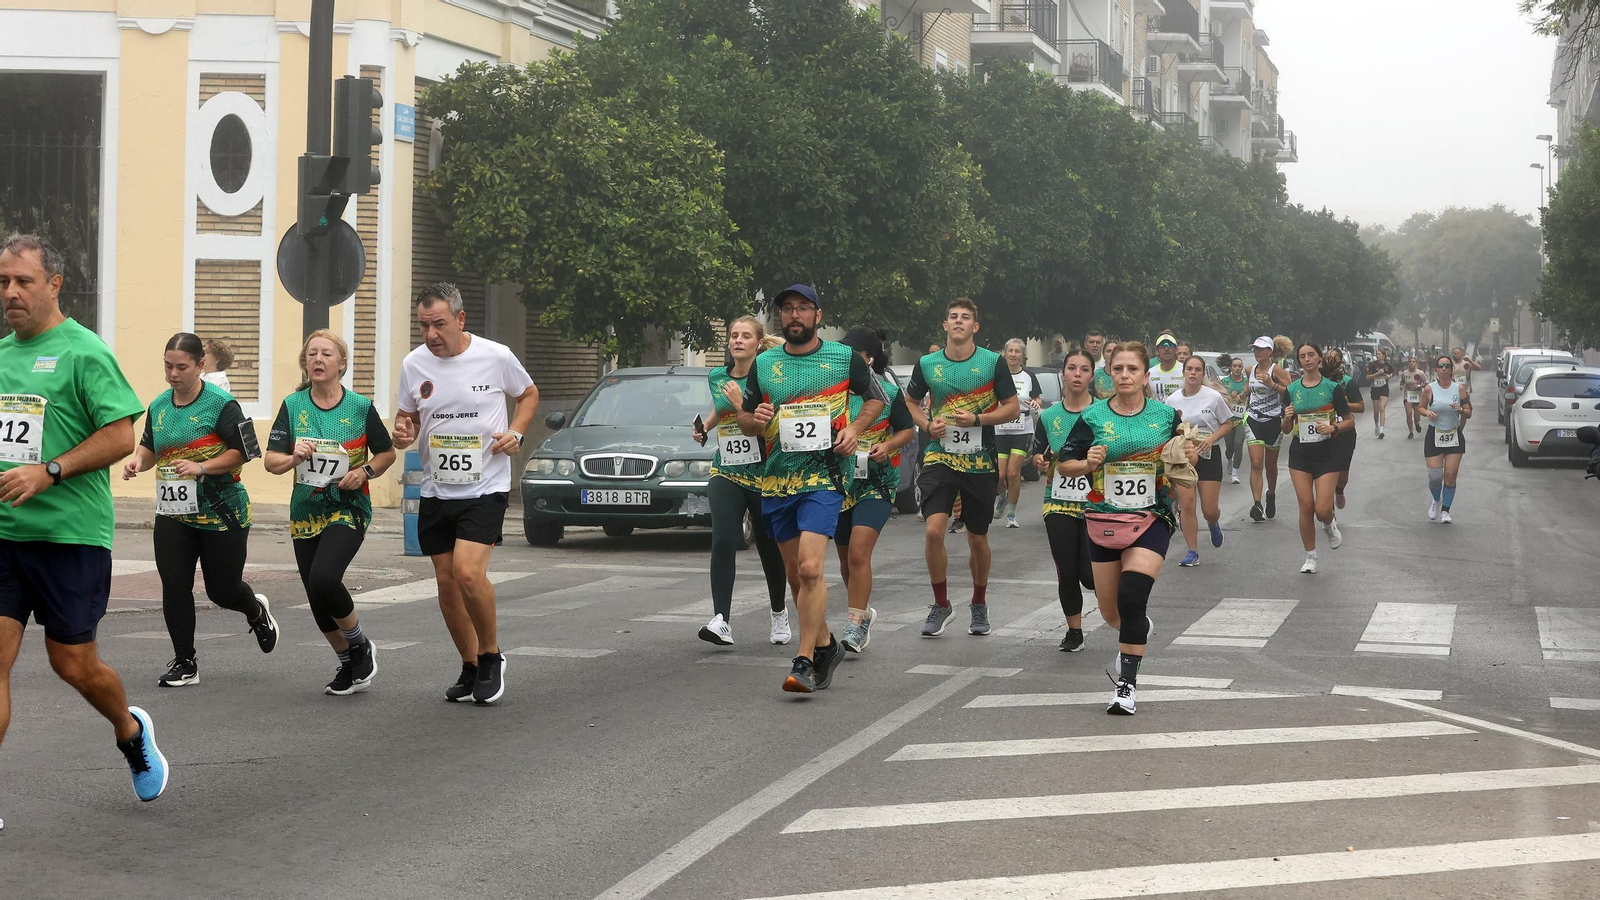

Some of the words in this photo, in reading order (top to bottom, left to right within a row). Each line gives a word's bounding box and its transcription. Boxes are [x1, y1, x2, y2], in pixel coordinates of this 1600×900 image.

[0, 420, 30, 444] 12
[794, 422, 816, 438] 32
[952, 430, 970, 444] 34
[1439, 434, 1454, 442] 437
[726, 439, 751, 454] 439
[306, 455, 339, 476] 177
[438, 454, 472, 471] 265
[1059, 476, 1086, 491] 246
[1114, 479, 1147, 496] 326
[161, 486, 188, 501] 218
[588, 492, 619, 503] 3818
[625, 492, 649, 503] BTR
